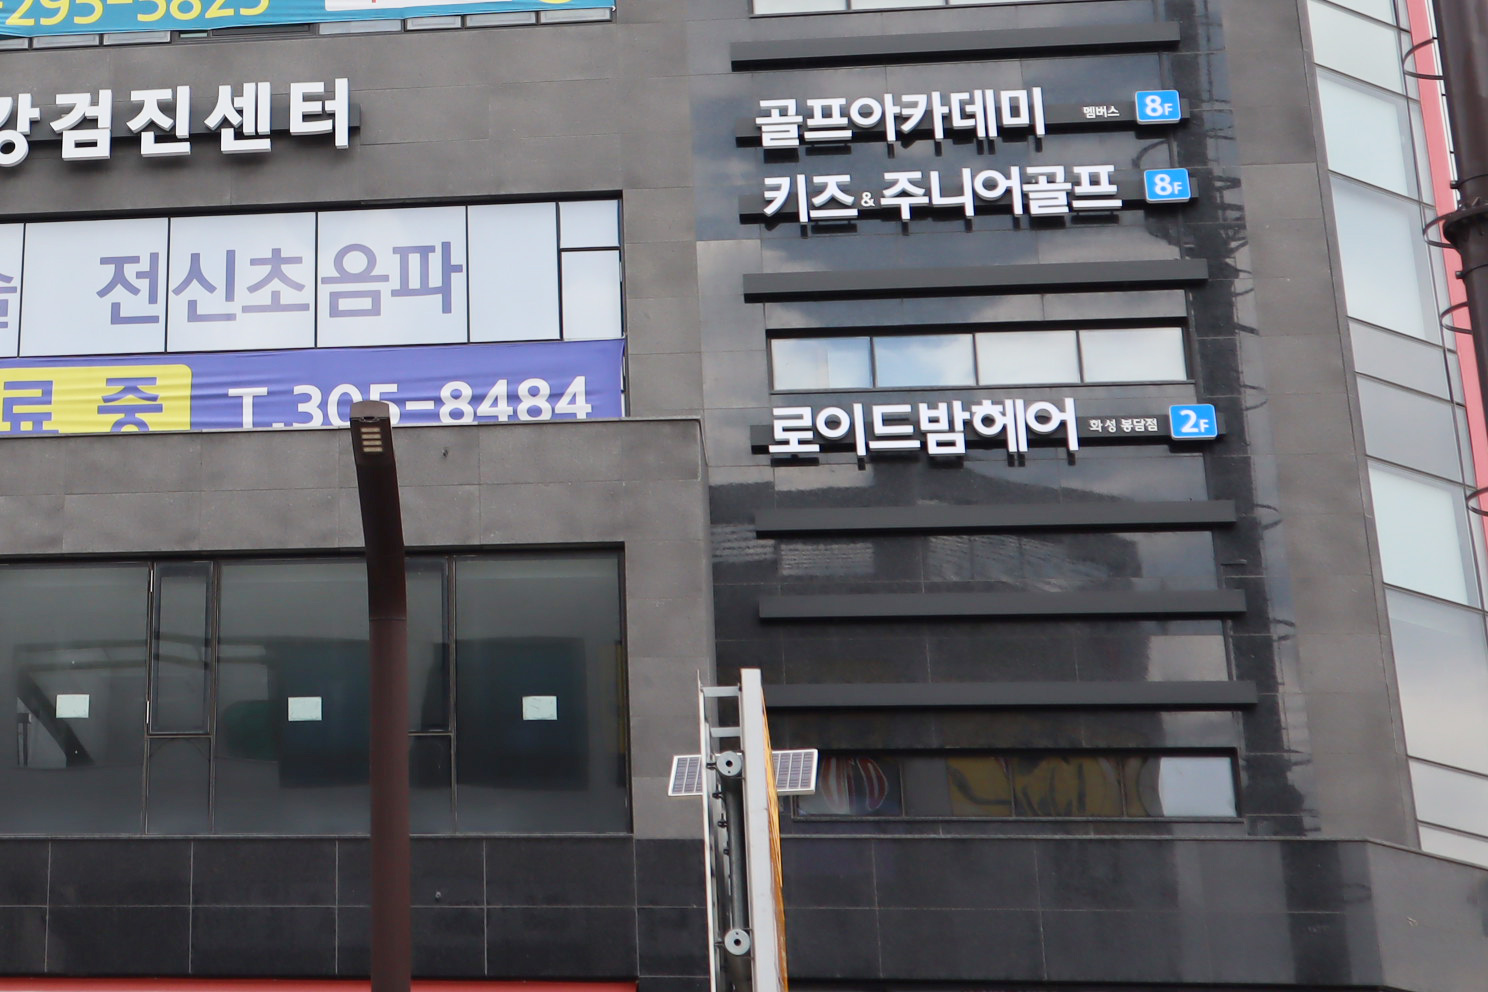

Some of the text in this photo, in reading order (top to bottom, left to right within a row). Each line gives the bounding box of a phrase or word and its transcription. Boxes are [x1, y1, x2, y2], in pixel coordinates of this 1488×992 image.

[755, 86, 1120, 149] 골프아카데미 멤버스
[1145, 95, 1173, 116] 8F
[1154, 174, 1182, 196] 8F
[96, 241, 463, 326] 전신초음파
[768, 397, 1080, 456] 로이드밤헤어
[1179, 409, 1210, 433] 2F
